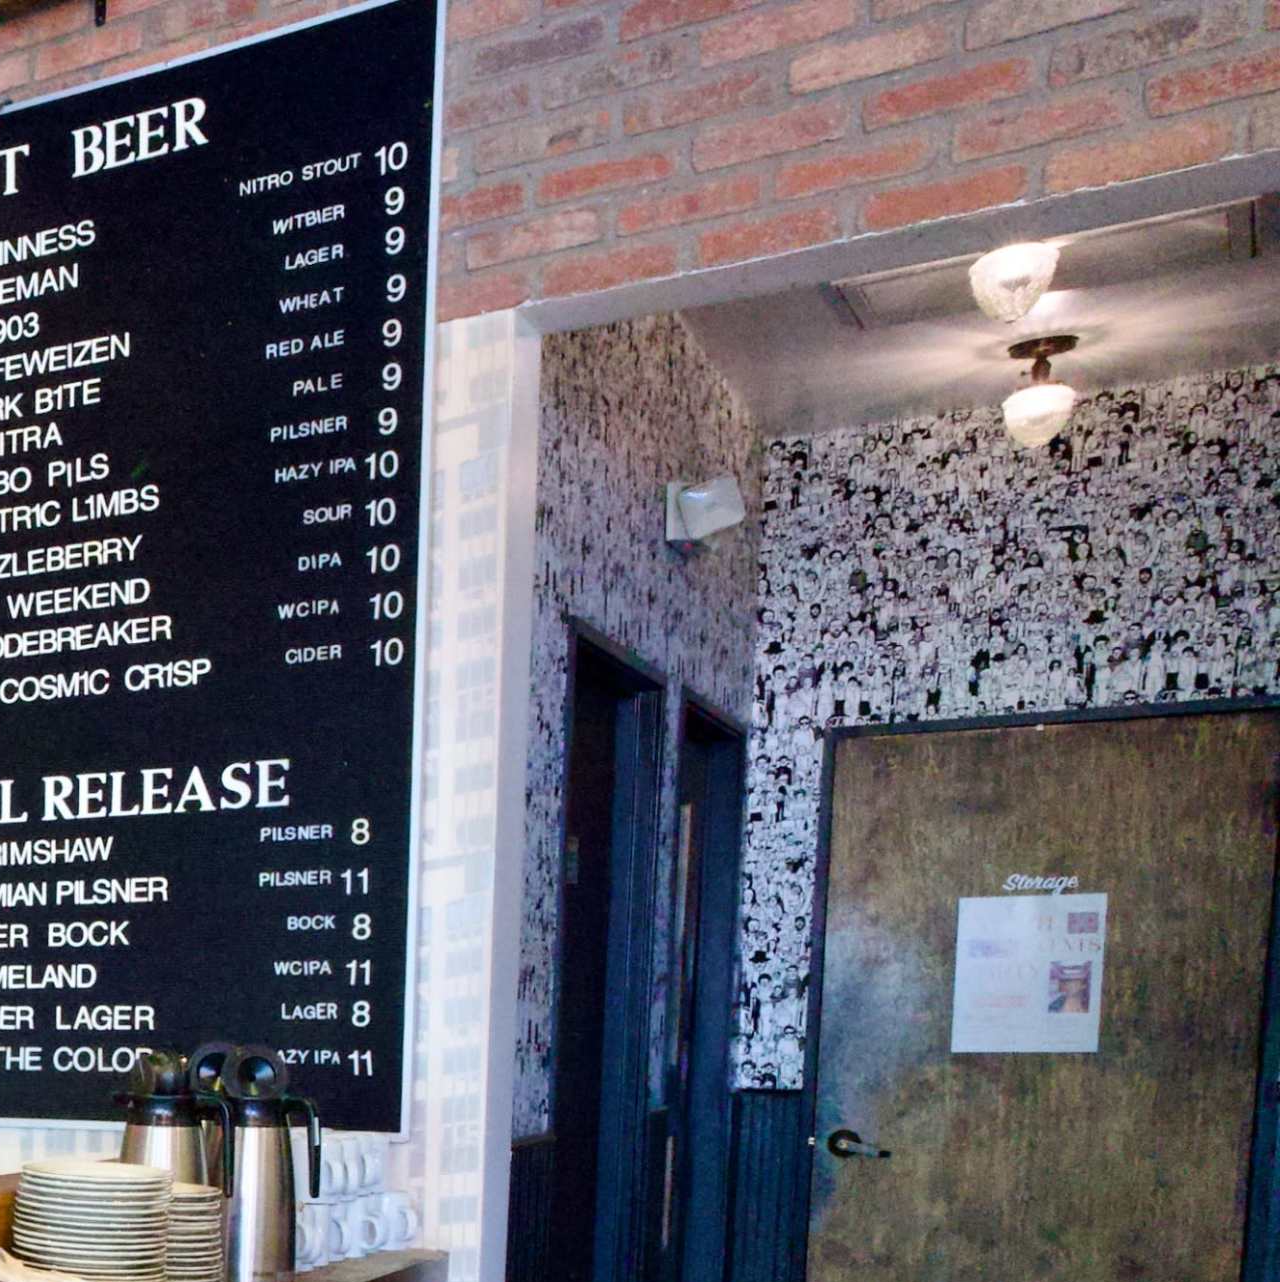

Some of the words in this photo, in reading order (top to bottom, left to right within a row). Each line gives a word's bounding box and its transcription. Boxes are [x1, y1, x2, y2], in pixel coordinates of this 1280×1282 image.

[71, 97, 209, 178] BEER
[239, 170, 294, 196] NITRO
[302, 152, 362, 181] STOUT
[374, 141, 408, 176] 10
[272, 204, 345, 235] WITBIER
[384, 186, 405, 216] 9
[284, 243, 344, 271] LAGER
[385, 226, 405, 255] 9
[278, 286, 344, 314] WHEAT
[386, 273, 407, 303] 9
[265, 338, 304, 359] RED
[310, 329, 345, 351] ALE
[382, 318, 403, 348] 9
[292, 372, 343, 397] PALE
[382, 362, 402, 391] 9
[270, 415, 348, 443] PILSNER
[378, 407, 398, 435] 9
[48, 452, 110, 488] PILS
[274, 461, 323, 484] HAZY
[329, 457, 356, 475] IPA
[364, 449, 399, 480] 10
[303, 503, 352, 525] SOUR
[364, 497, 396, 527] 10
[298, 552, 342, 572] DIPA
[365, 543, 401, 574] 10
[6, 577, 151, 619] WEEKEND
[369, 590, 404, 620] 10
[285, 644, 342, 665] CIDER
[370, 637, 404, 667] 10
[41, 758, 290, 822] RELEASE
[259, 824, 333, 843] PILSNER
[350, 817, 370, 845] 8
[56, 876, 168, 906] PILSNER
[258, 869, 332, 887] PILSNER
[340, 867, 369, 896] 11
[1002, 873, 1080, 896] Storage
[47, 920, 130, 948] BOCK
[286, 914, 336, 931] BOCK
[351, 913, 372, 940] 8
[345, 959, 371, 986] 11
[55, 1005, 155, 1031] LAGER
[351, 1000, 371, 1027] 8
[314, 1049, 341, 1065] IPA
[347, 1050, 373, 1076] 11
